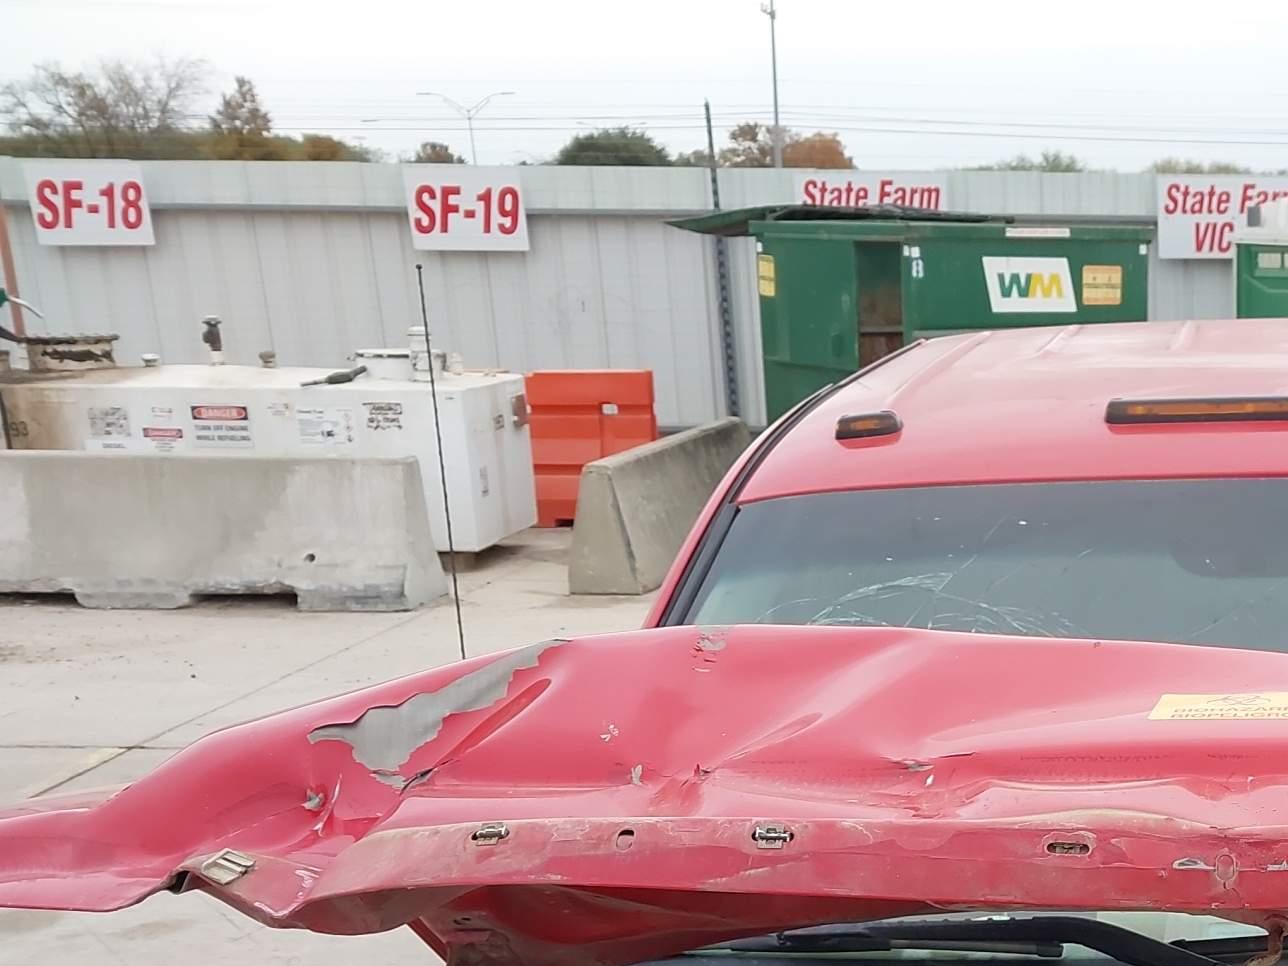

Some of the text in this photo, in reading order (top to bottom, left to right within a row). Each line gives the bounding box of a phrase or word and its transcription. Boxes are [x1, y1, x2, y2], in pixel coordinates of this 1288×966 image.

[36, 178, 143, 230] SF-18
[414, 184, 520, 235] SF-19
[804, 179, 941, 209] State Farm
[1164, 183, 1231, 215] State
[1194, 222, 1234, 253] VIC
[998, 271, 1064, 299] WM
[201, 407, 239, 418] DANGER
